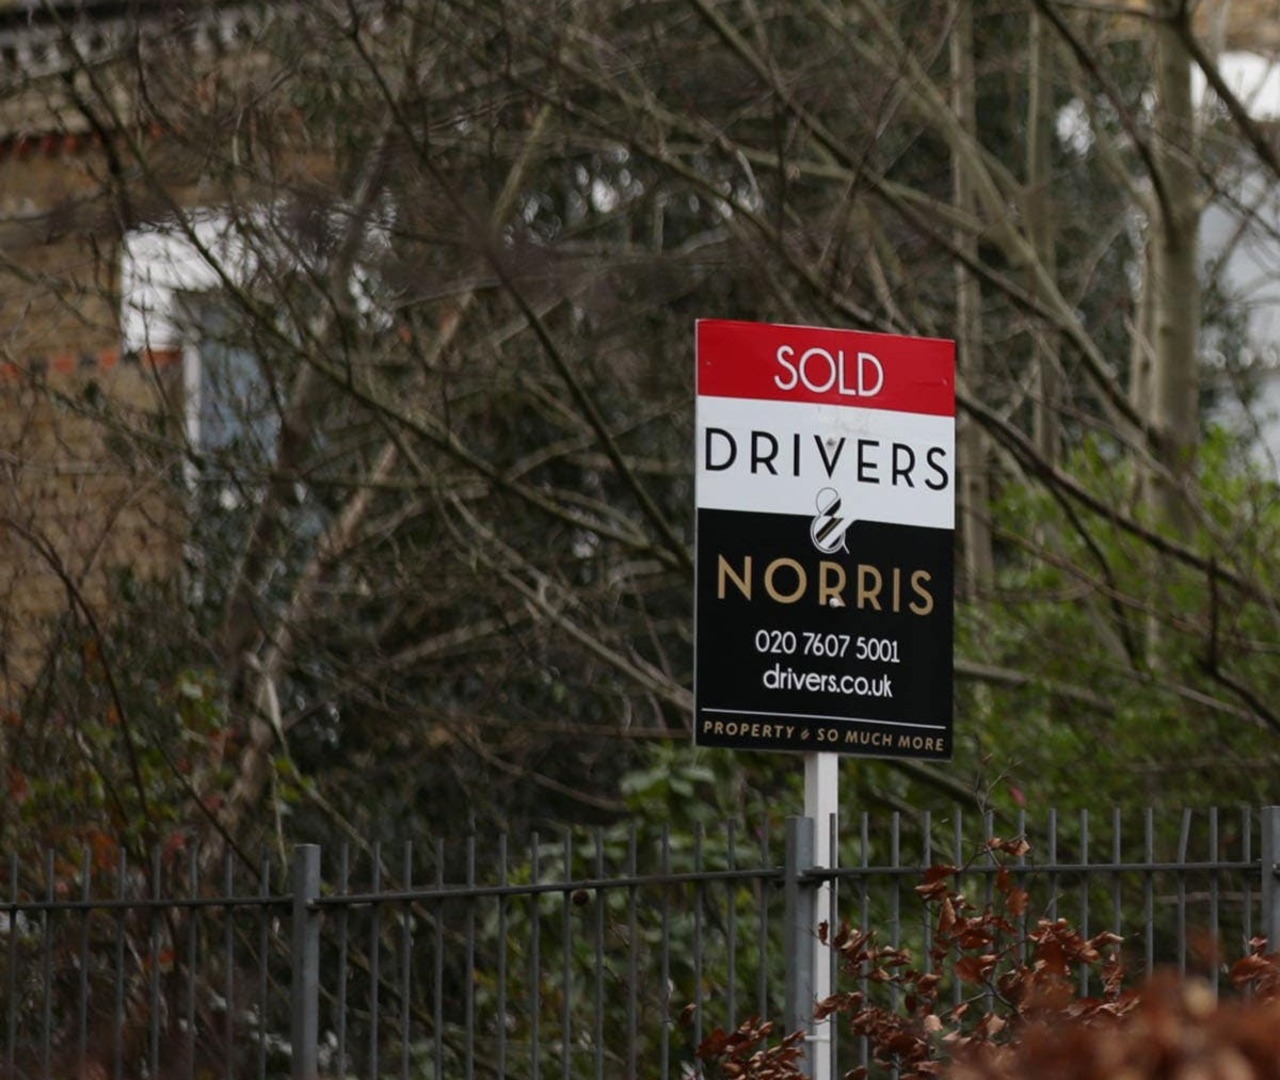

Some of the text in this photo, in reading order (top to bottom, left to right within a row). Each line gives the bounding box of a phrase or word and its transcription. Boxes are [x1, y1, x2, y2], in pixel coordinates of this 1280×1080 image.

[774, 345, 884, 397] SOLD
[704, 427, 950, 491] DRIVERS
[810, 486, 850, 554] &
[717, 554, 935, 616] NORRIS
[755, 629, 900, 663] 020 7607 5001
[762, 663, 893, 698] drivers.co.uk
[703, 720, 796, 740] PROPERTY
[817, 728, 840, 742] SO
[845, 730, 893, 747] MUCH
[898, 735, 945, 752] MORE
